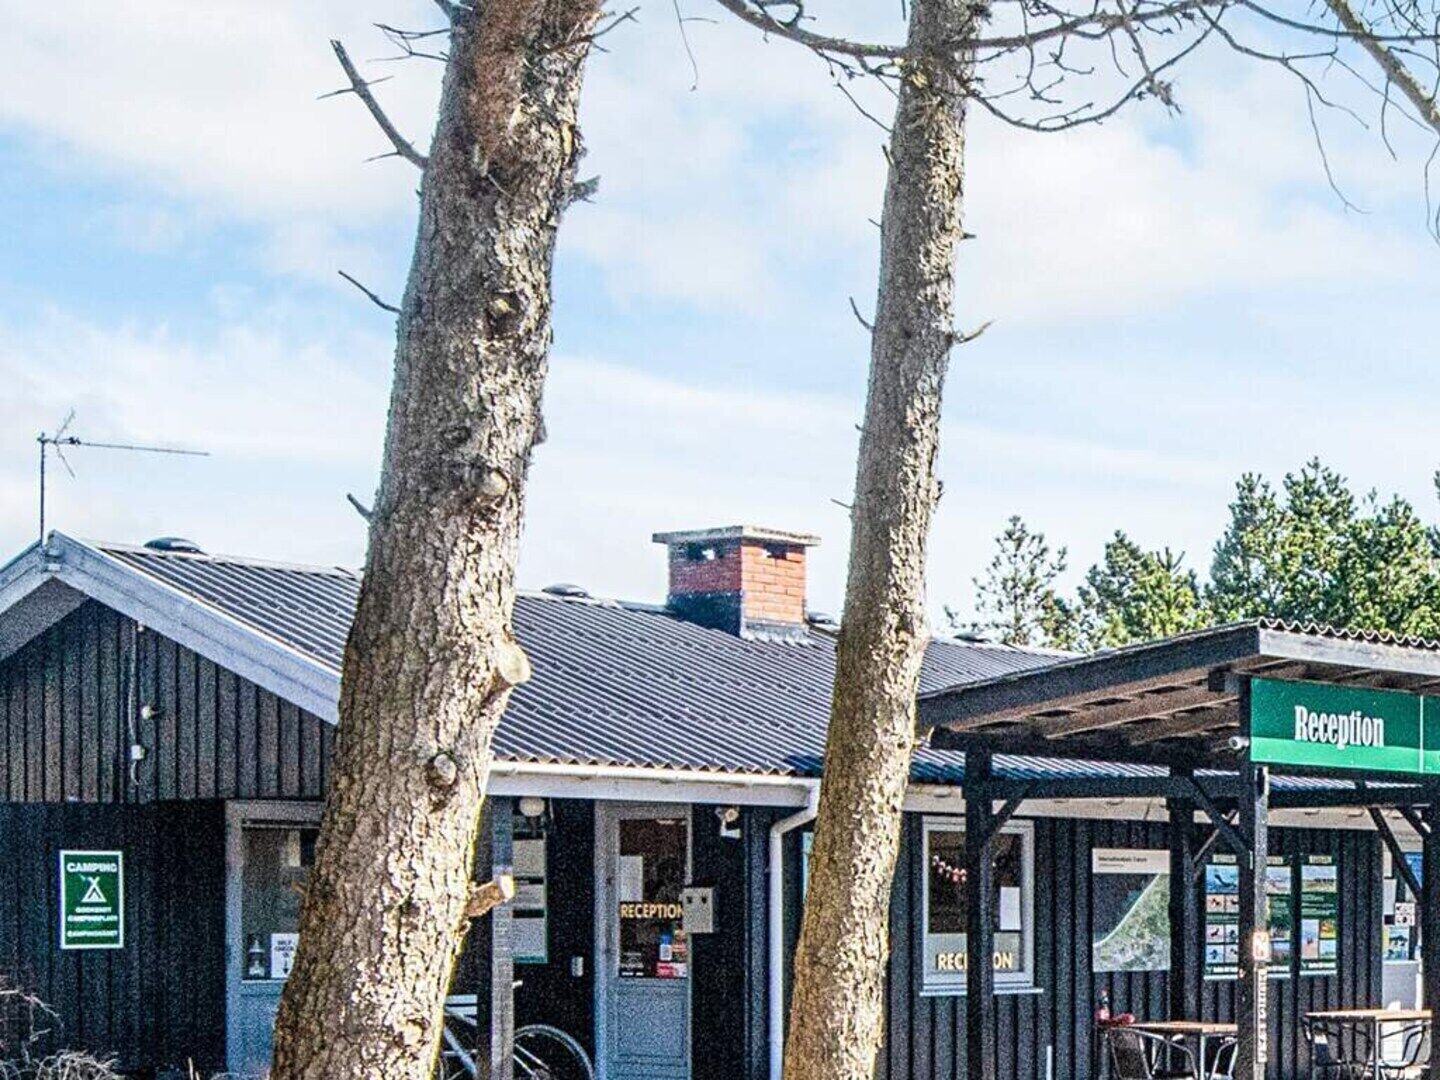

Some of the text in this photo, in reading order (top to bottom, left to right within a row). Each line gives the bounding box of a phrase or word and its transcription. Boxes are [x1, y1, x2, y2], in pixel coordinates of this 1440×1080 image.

[1294, 704, 1385, 750] Reception
[66, 862, 118, 873] CAMPING
[938, 952, 1012, 971] RECON
